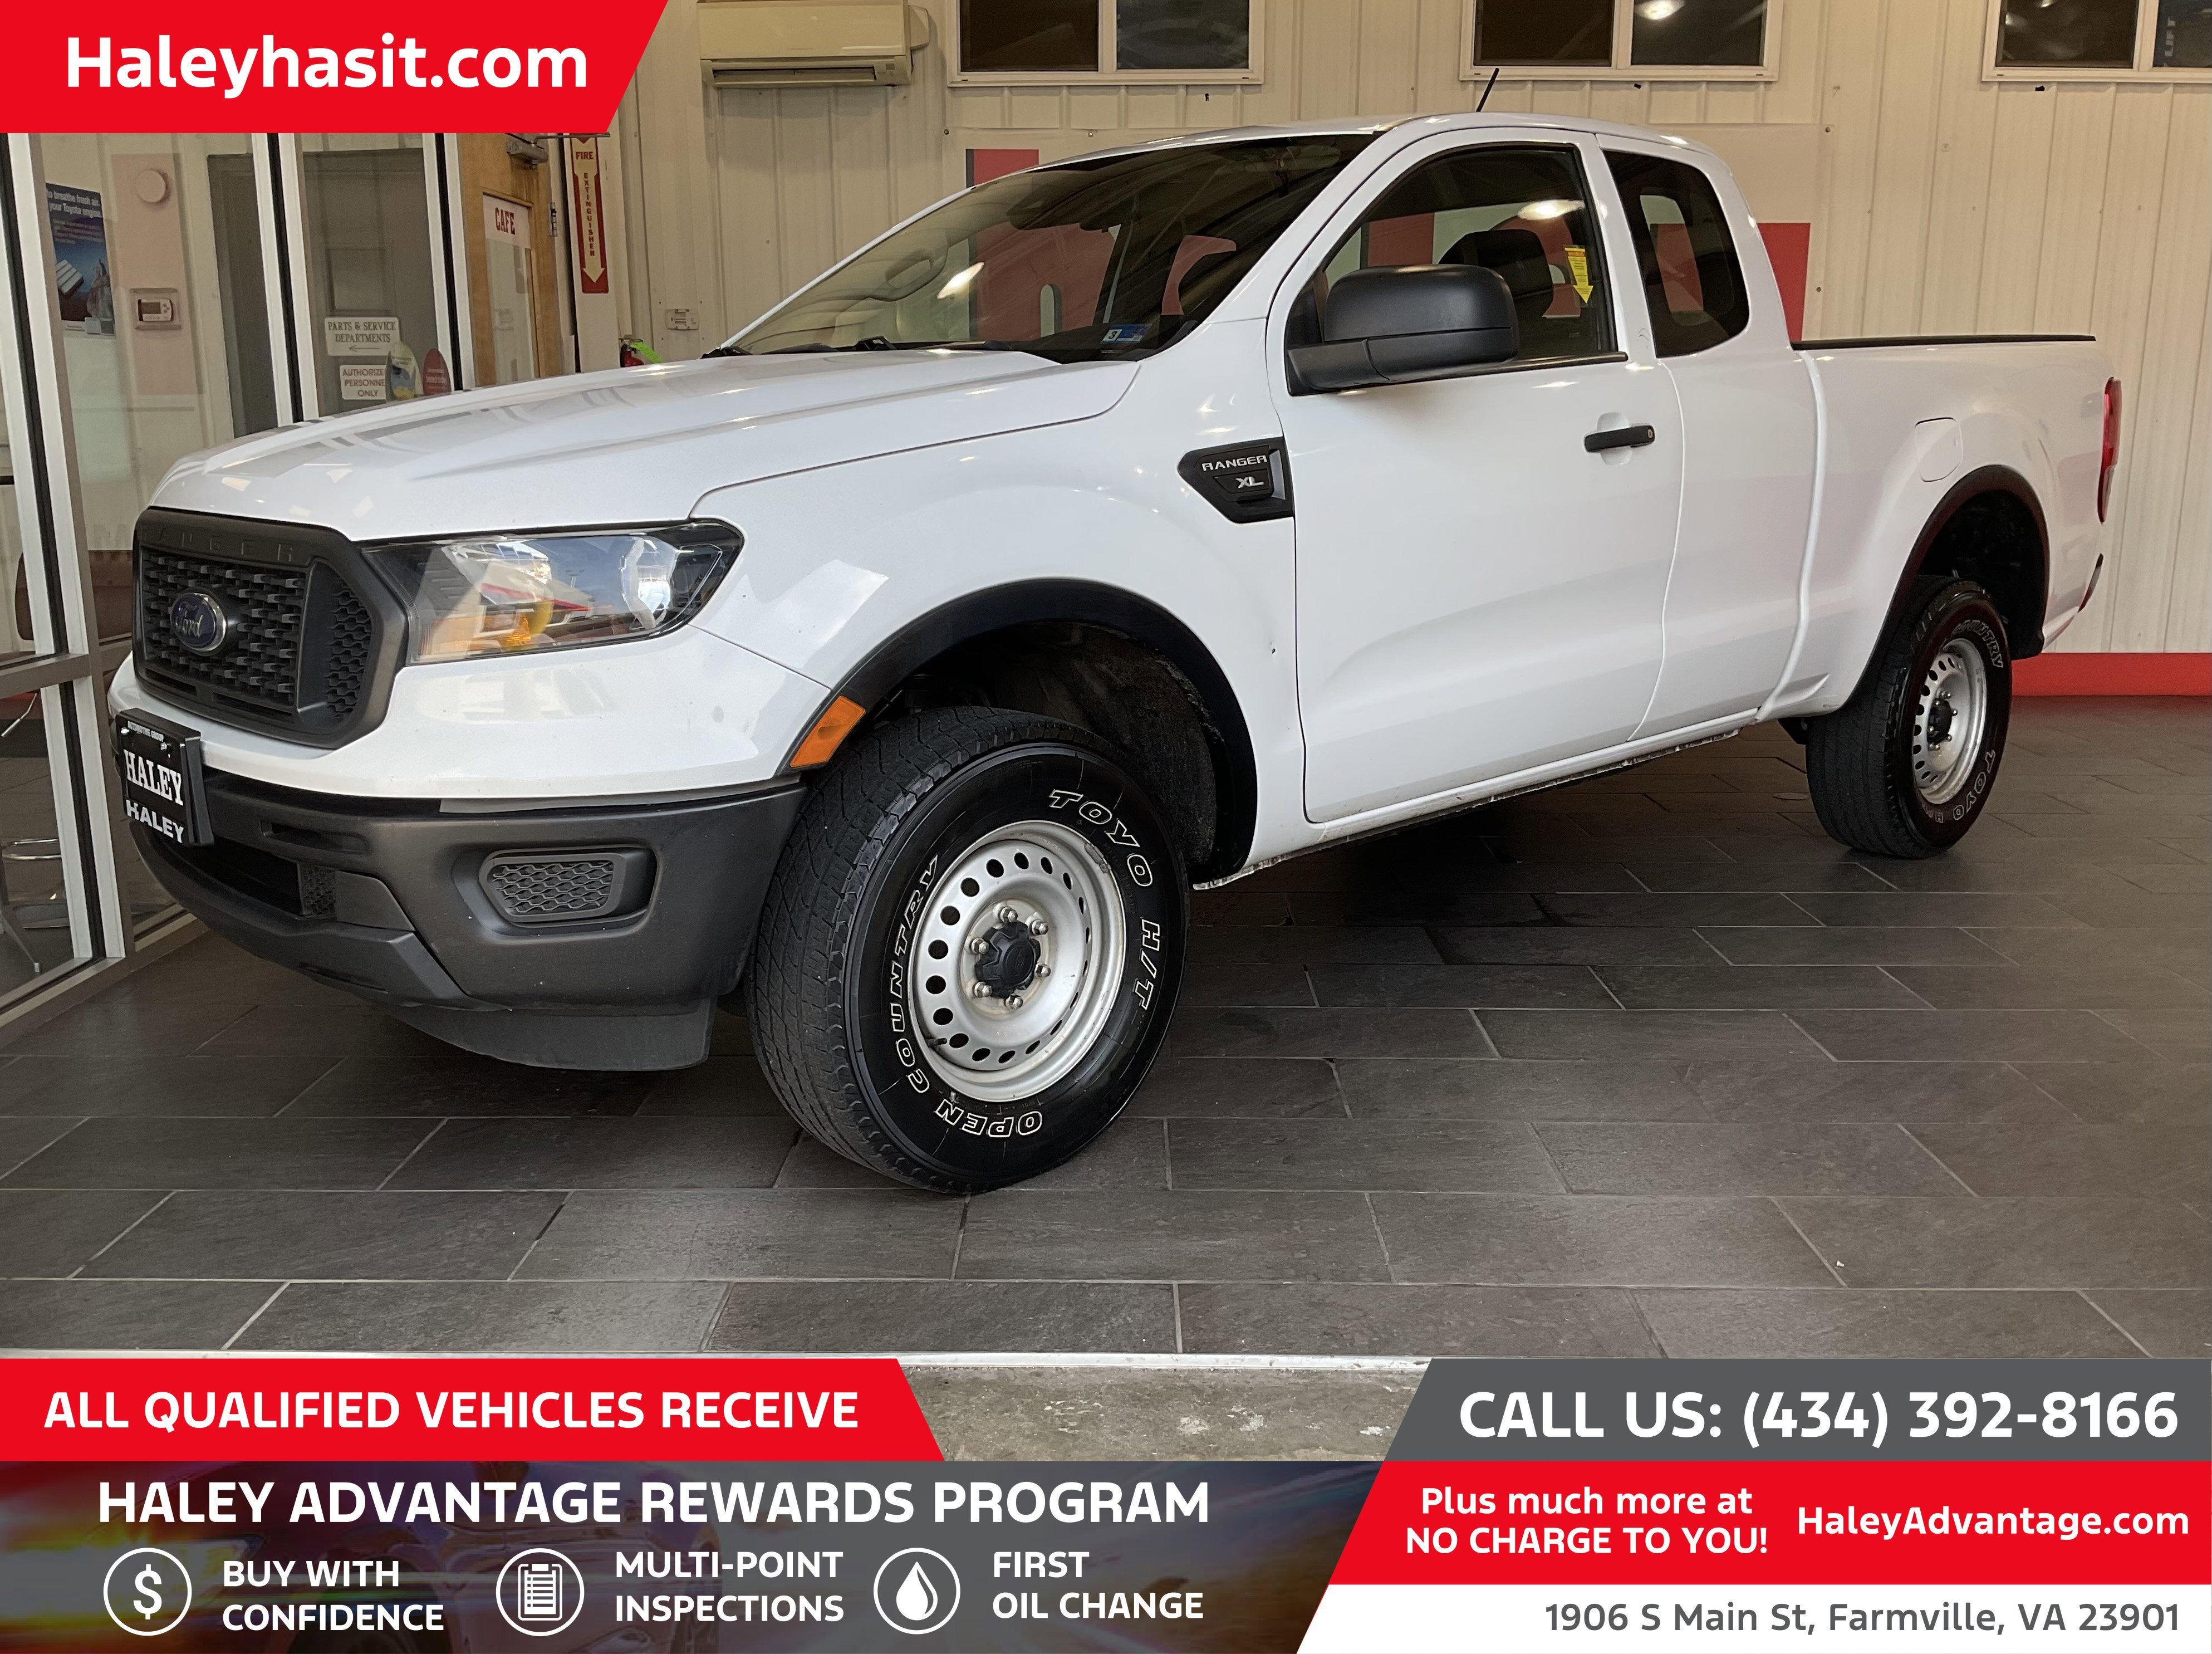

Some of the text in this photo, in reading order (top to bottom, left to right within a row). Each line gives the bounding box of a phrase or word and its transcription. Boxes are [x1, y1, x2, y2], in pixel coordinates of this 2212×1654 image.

[576, 151, 594, 160] FIRE
[62, 203, 81, 215] Toyota
[495, 207, 516, 235] CAFE
[584, 173, 595, 257] EXTINGUISHER
[328, 321, 396, 331] PARTS & SERVICE
[335, 334, 391, 342] DEPARTMENTS
[1109, 331, 1118, 339] 3
[1201, 454, 1267, 471] RANGER
[1235, 476, 1264, 489] XL
[174, 601, 204, 638] Ford
[123, 748, 184, 806] HALEY
[1953, 750, 1996, 820] TOYO
[126, 799, 184, 844] HALEY
[1048, 789, 1161, 1011] TOYO H/T
[890, 853, 1043, 1138] OPEN COUNTRY
